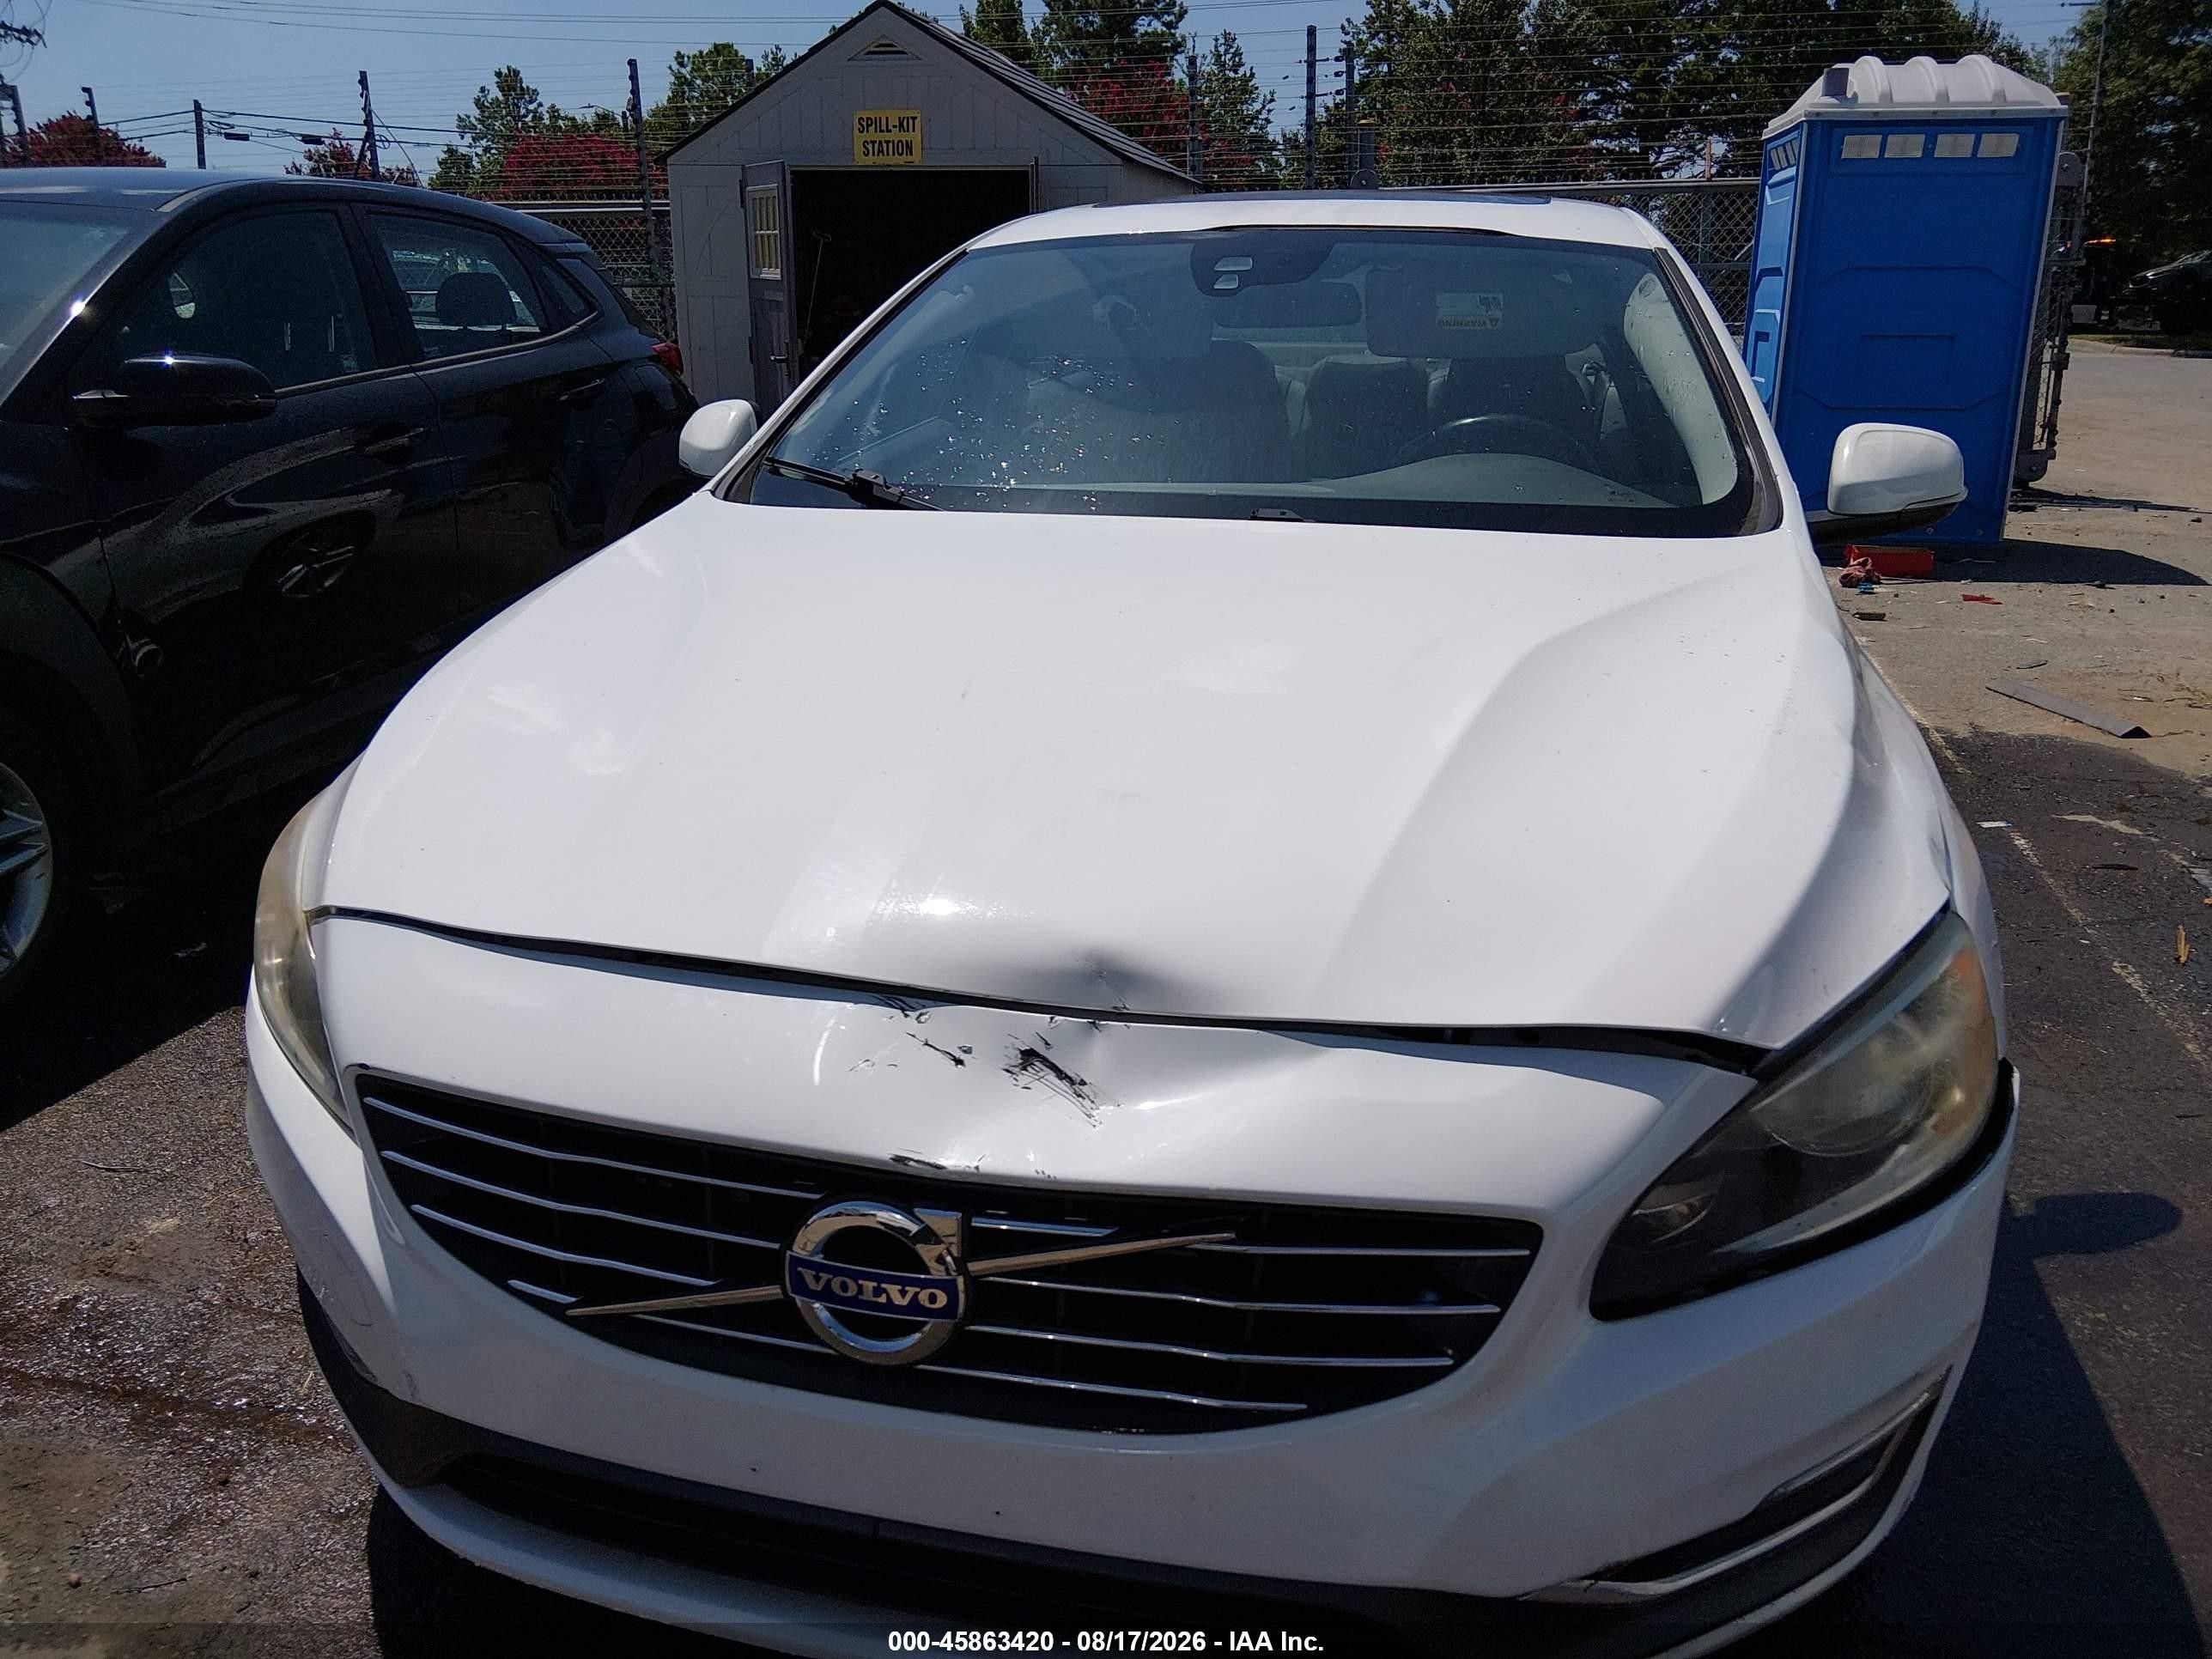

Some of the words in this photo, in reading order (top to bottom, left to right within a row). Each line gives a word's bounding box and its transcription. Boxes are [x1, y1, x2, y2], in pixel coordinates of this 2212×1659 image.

[857, 116, 918, 134] SPILL-KIT
[862, 139, 914, 157] STATION
[797, 1267, 948, 1309] VOLVO
